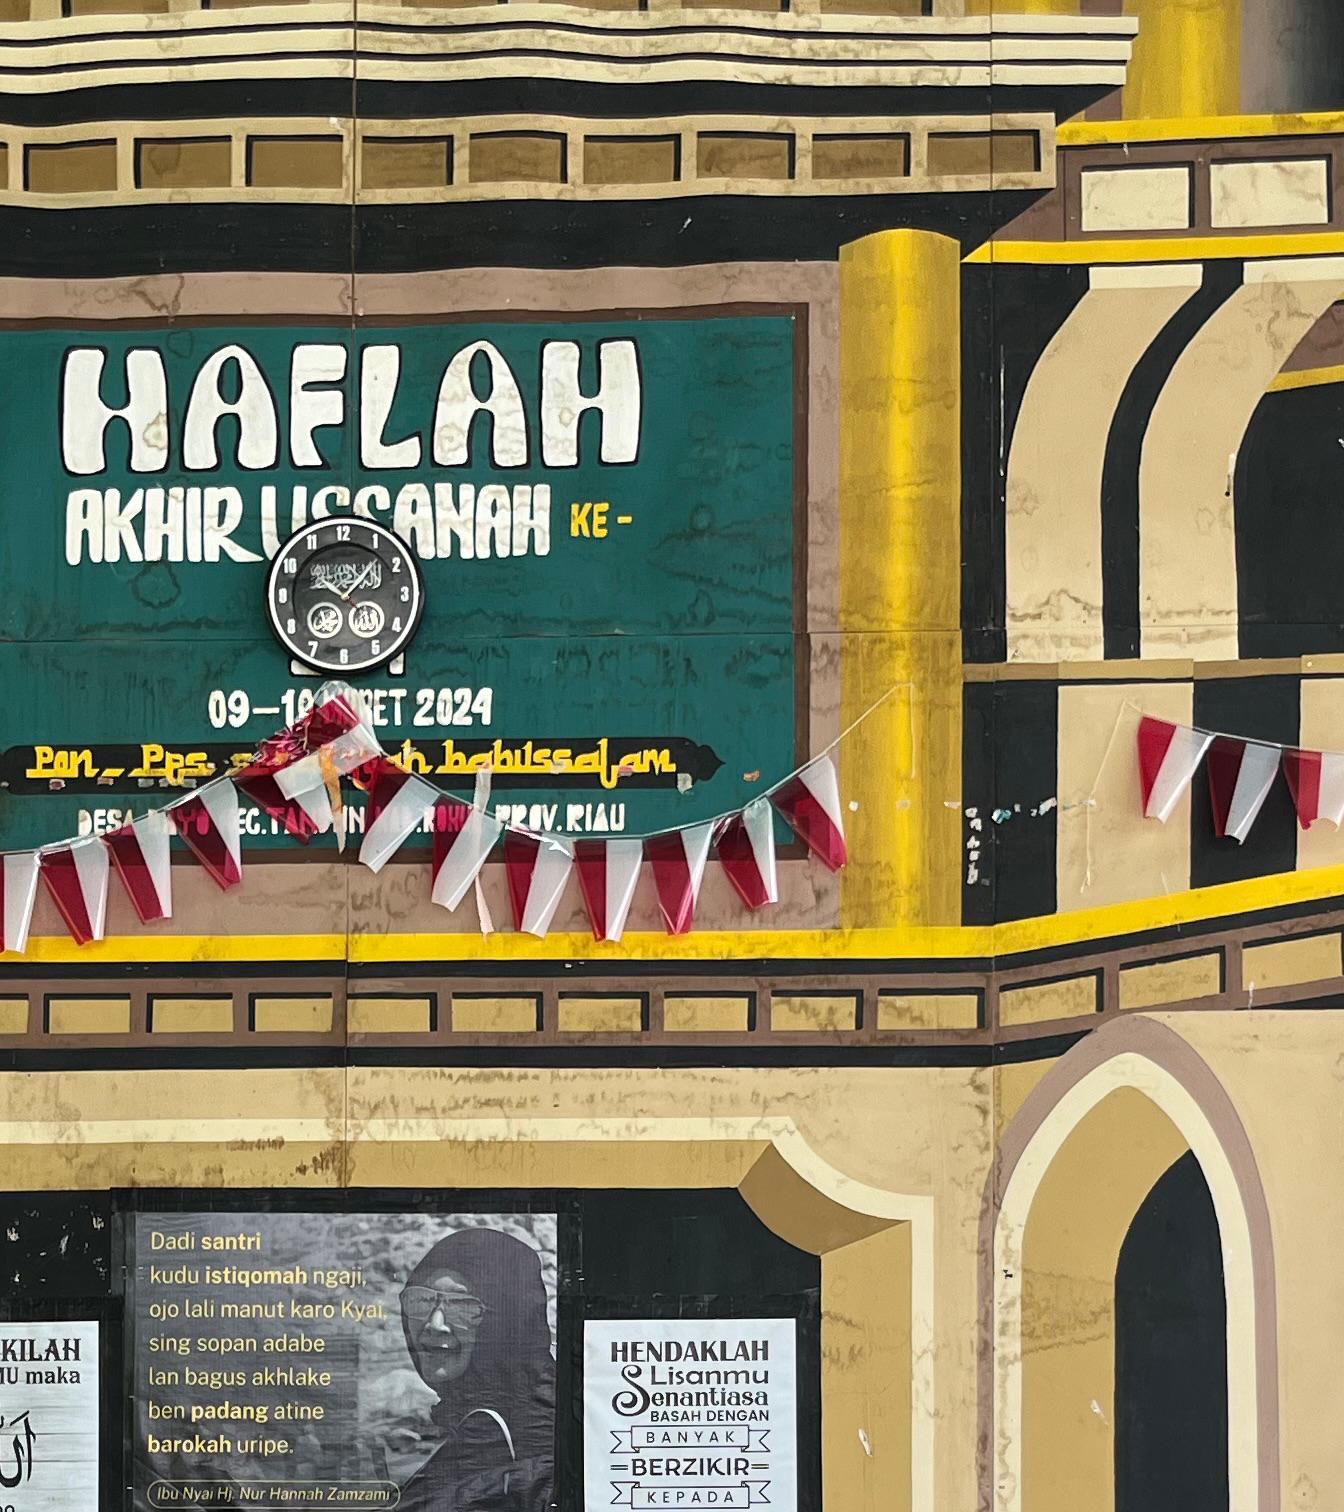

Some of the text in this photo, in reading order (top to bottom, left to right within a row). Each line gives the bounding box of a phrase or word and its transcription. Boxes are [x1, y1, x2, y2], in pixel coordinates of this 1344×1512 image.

[62, 339, 641, 474] HAFLAH
[66, 485, 263, 565] AKHIR
[336, 525, 350, 541] 12
[307, 534, 317, 550] 11
[372, 533, 379, 549] 1
[283, 558, 297, 574] 10
[392, 557, 401, 573] 2
[279, 587, 288, 603] 9
[400, 586, 409, 602] 3
[287, 618, 296, 634] 8
[391, 616, 402, 632] 4
[308, 641, 318, 657] 7
[339, 648, 348, 664] 6
[371, 640, 380, 655] 5
[413, 687, 493, 726] 2024
[436, 738, 676, 790] babussalam
[151, 1231, 262, 1251] Dadi santri
[150, 1265, 367, 1288] kudu istiqomah ngaji,
[149, 1300, 179, 1321] ojo
[184, 1299, 215, 1318] lali
[220, 1301, 284, 1319] manut
[290, 1300, 335, 1319] karo
[149, 1333, 325, 1355] sing sopan adabe
[611, 1339, 769, 1362] HENDAKLAH
[25, 1366, 81, 1385] maka
[148, 1366, 331, 1389] lan bagus akhlake
[650, 1365, 769, 1386] Lisanmu
[612, 1364, 769, 1417] Senantiasa
[148, 1401, 325, 1423] ben padang atine
[650, 1409, 769, 1422] BASAH DENGAN
[147, 1435, 294, 1457] barokah uripe.
[646, 1430, 735, 1444] BANYAK
[631, 1457, 750, 1476] BERZIKIR
[157, 1487, 391, 1504] Ibu Nyai Hj. Nur Hannah Zamzami
[647, 1491, 734, 1504] KEPADA
